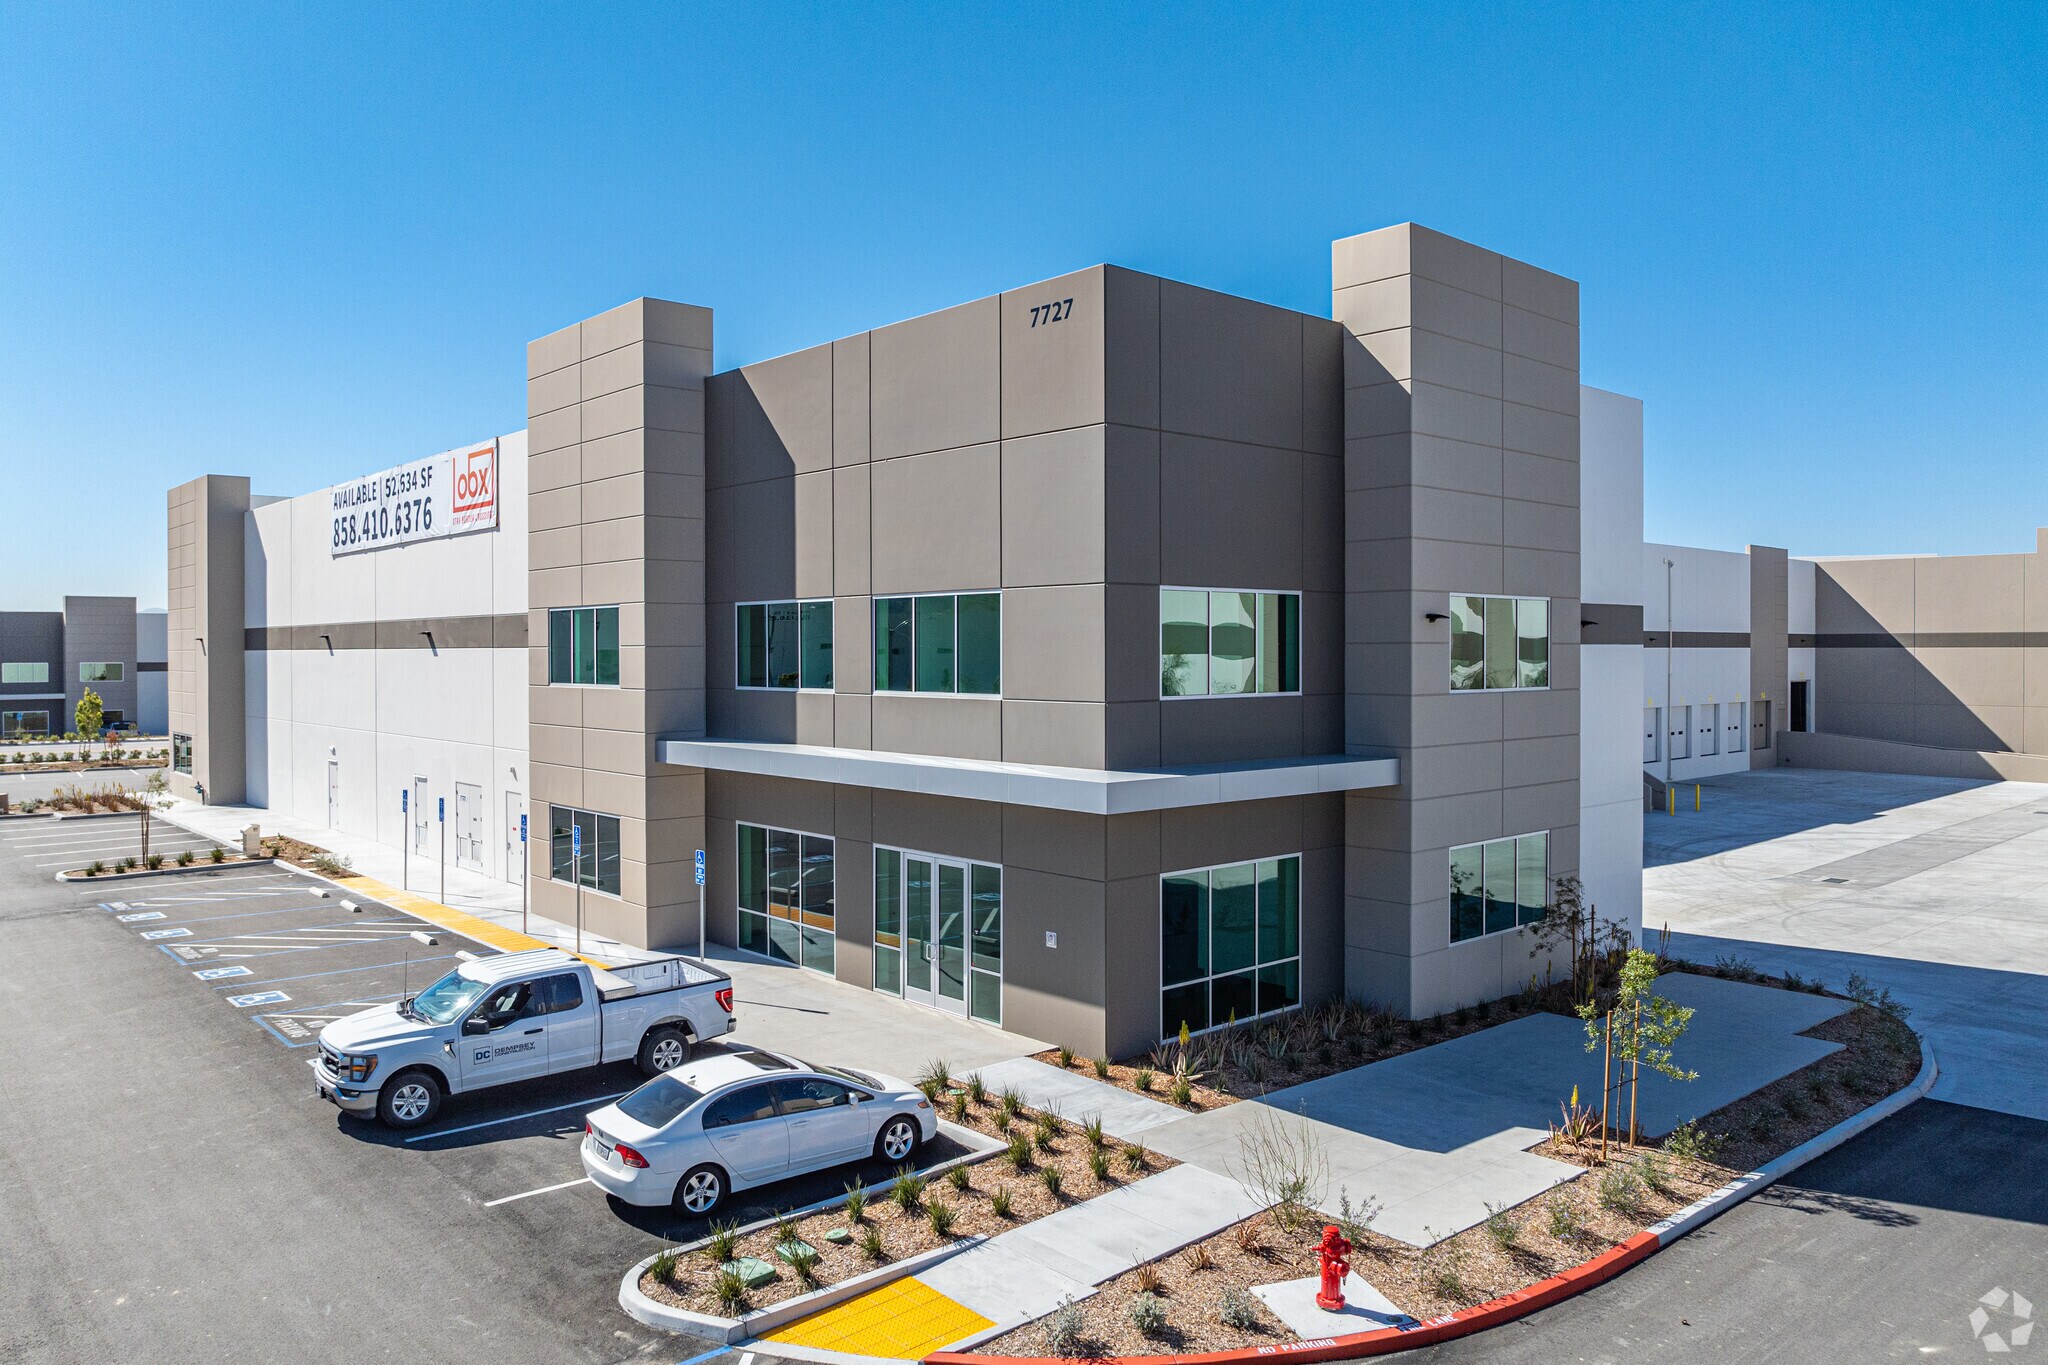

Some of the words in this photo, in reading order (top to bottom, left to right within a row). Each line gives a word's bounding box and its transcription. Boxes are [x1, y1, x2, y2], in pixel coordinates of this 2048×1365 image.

[1030, 298, 1074, 328] 7727
[333, 481, 377, 511] AVAILABLE
[385, 470, 417, 499] 52,634
[421, 465, 433, 488] SF
[457, 455, 489, 500] obx
[333, 496, 432, 547] 858.410.6376
[475, 1050, 491, 1061] DC
[494, 1041, 535, 1054] DEMPSEY
[1257, 1346, 1276, 1355] NO
[1282, 1338, 1337, 1352] PARKING
[1426, 1315, 1459, 1327] LANE
